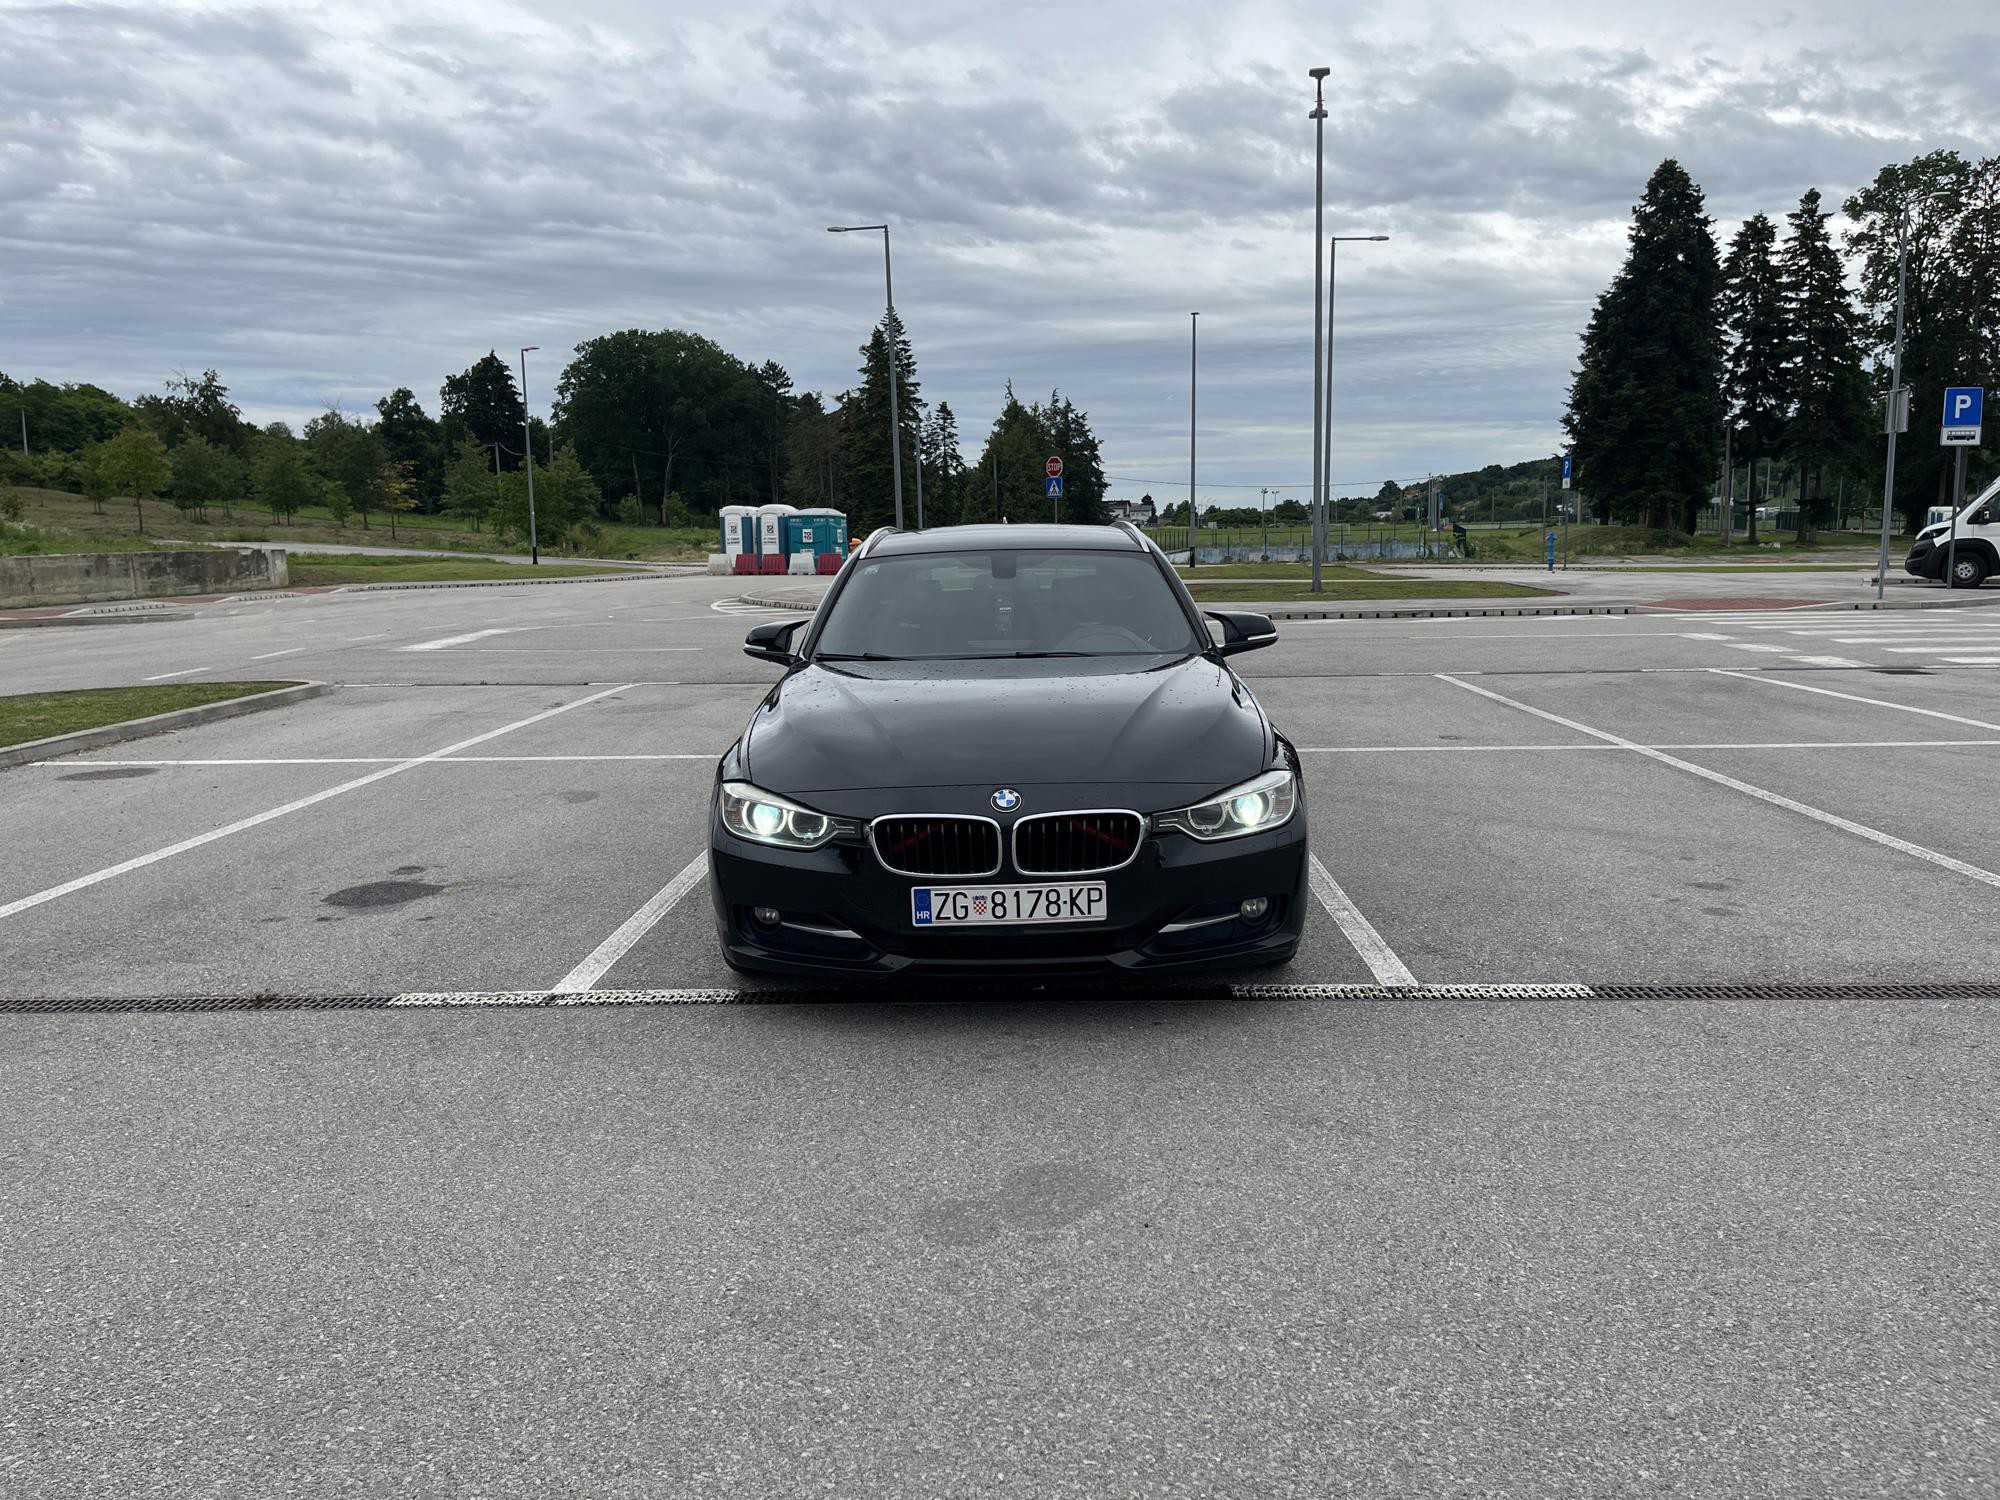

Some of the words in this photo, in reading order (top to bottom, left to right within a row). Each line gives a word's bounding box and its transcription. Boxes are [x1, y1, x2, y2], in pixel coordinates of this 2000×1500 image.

[1954, 394, 1972, 419] P
[1048, 463, 1062, 472] STOP
[933, 892, 968, 921] ZG
[916, 911, 930, 920] HR
